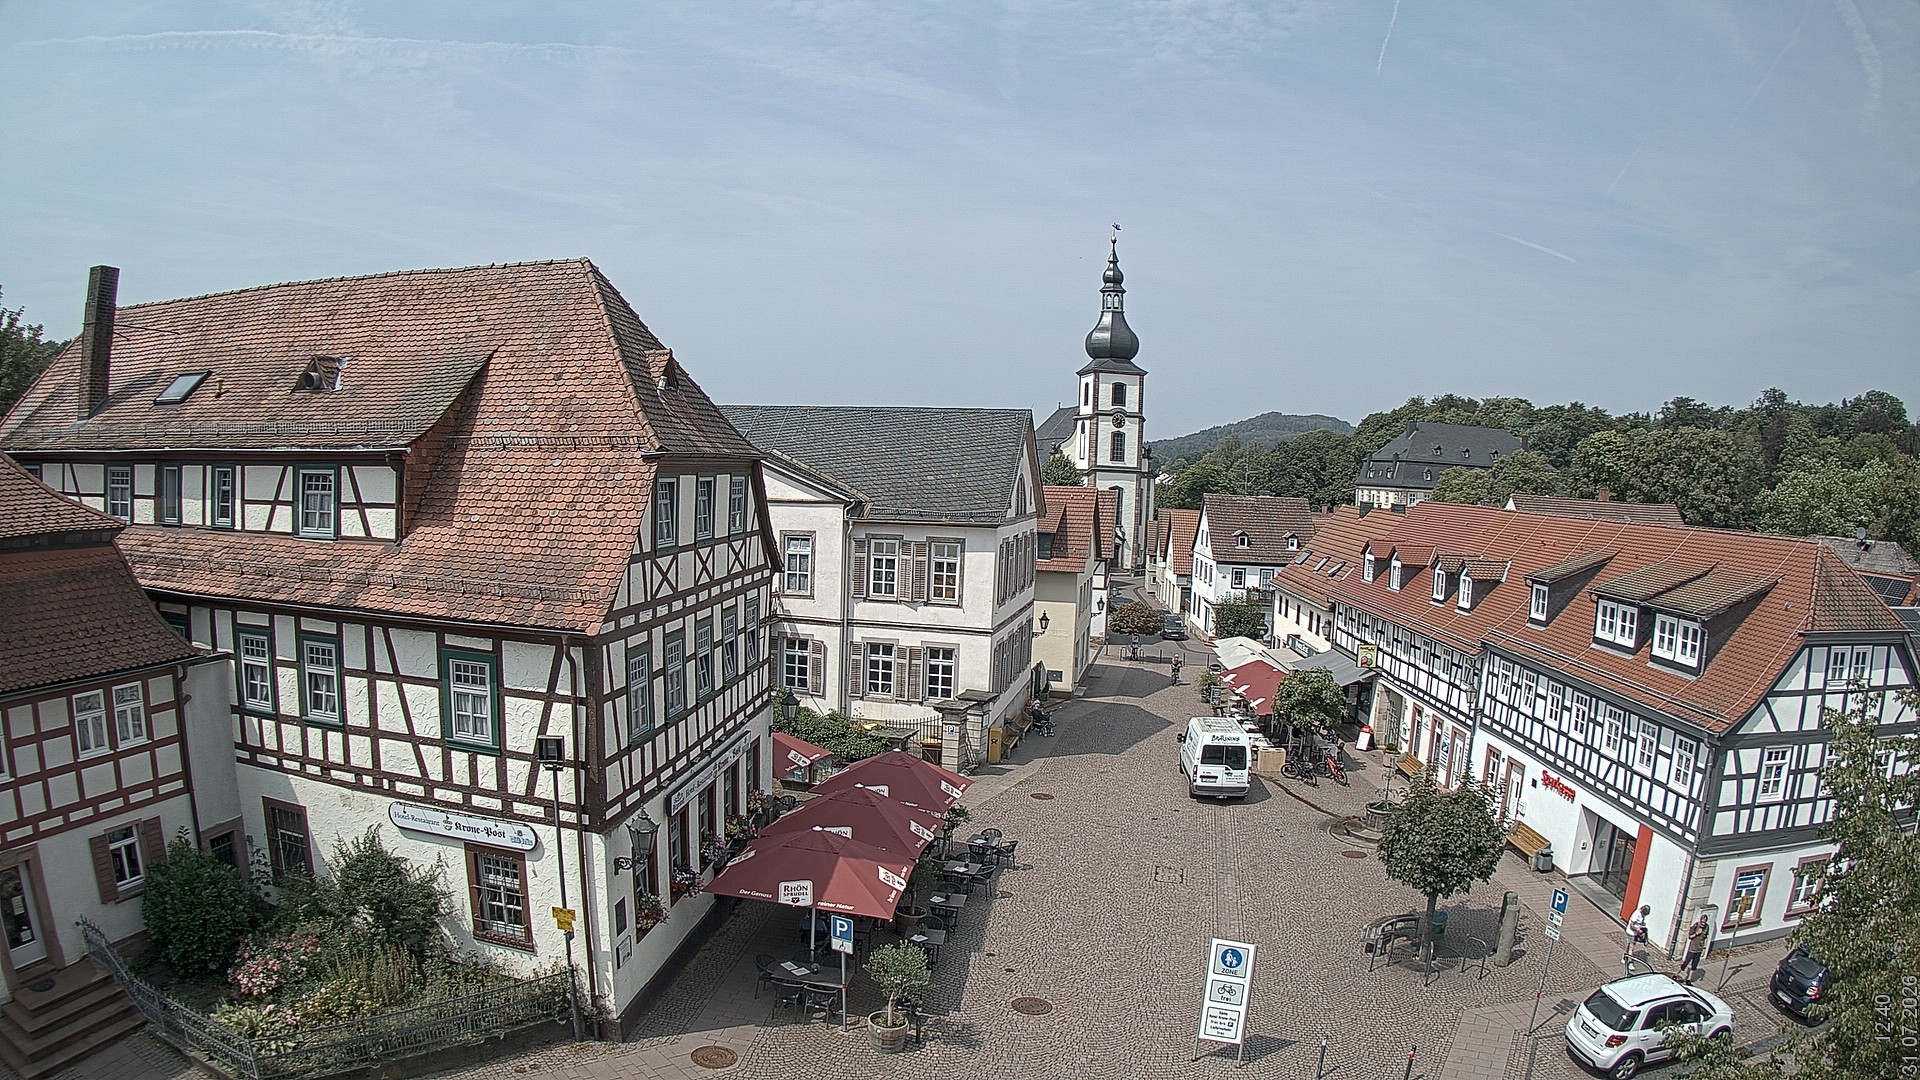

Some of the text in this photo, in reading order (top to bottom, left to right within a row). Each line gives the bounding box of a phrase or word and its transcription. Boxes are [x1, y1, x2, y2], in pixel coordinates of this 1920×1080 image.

[394, 811, 506, 838] Hotel-Restaurant Krone-Post
[783, 884, 808, 892] RHÖN
[751, 890, 773, 898] Genuss
[1554, 892, 1565, 908] P
[836, 903, 855, 911] Natur
[836, 919, 848, 936] P
[1221, 968, 1238, 976] ZONE
